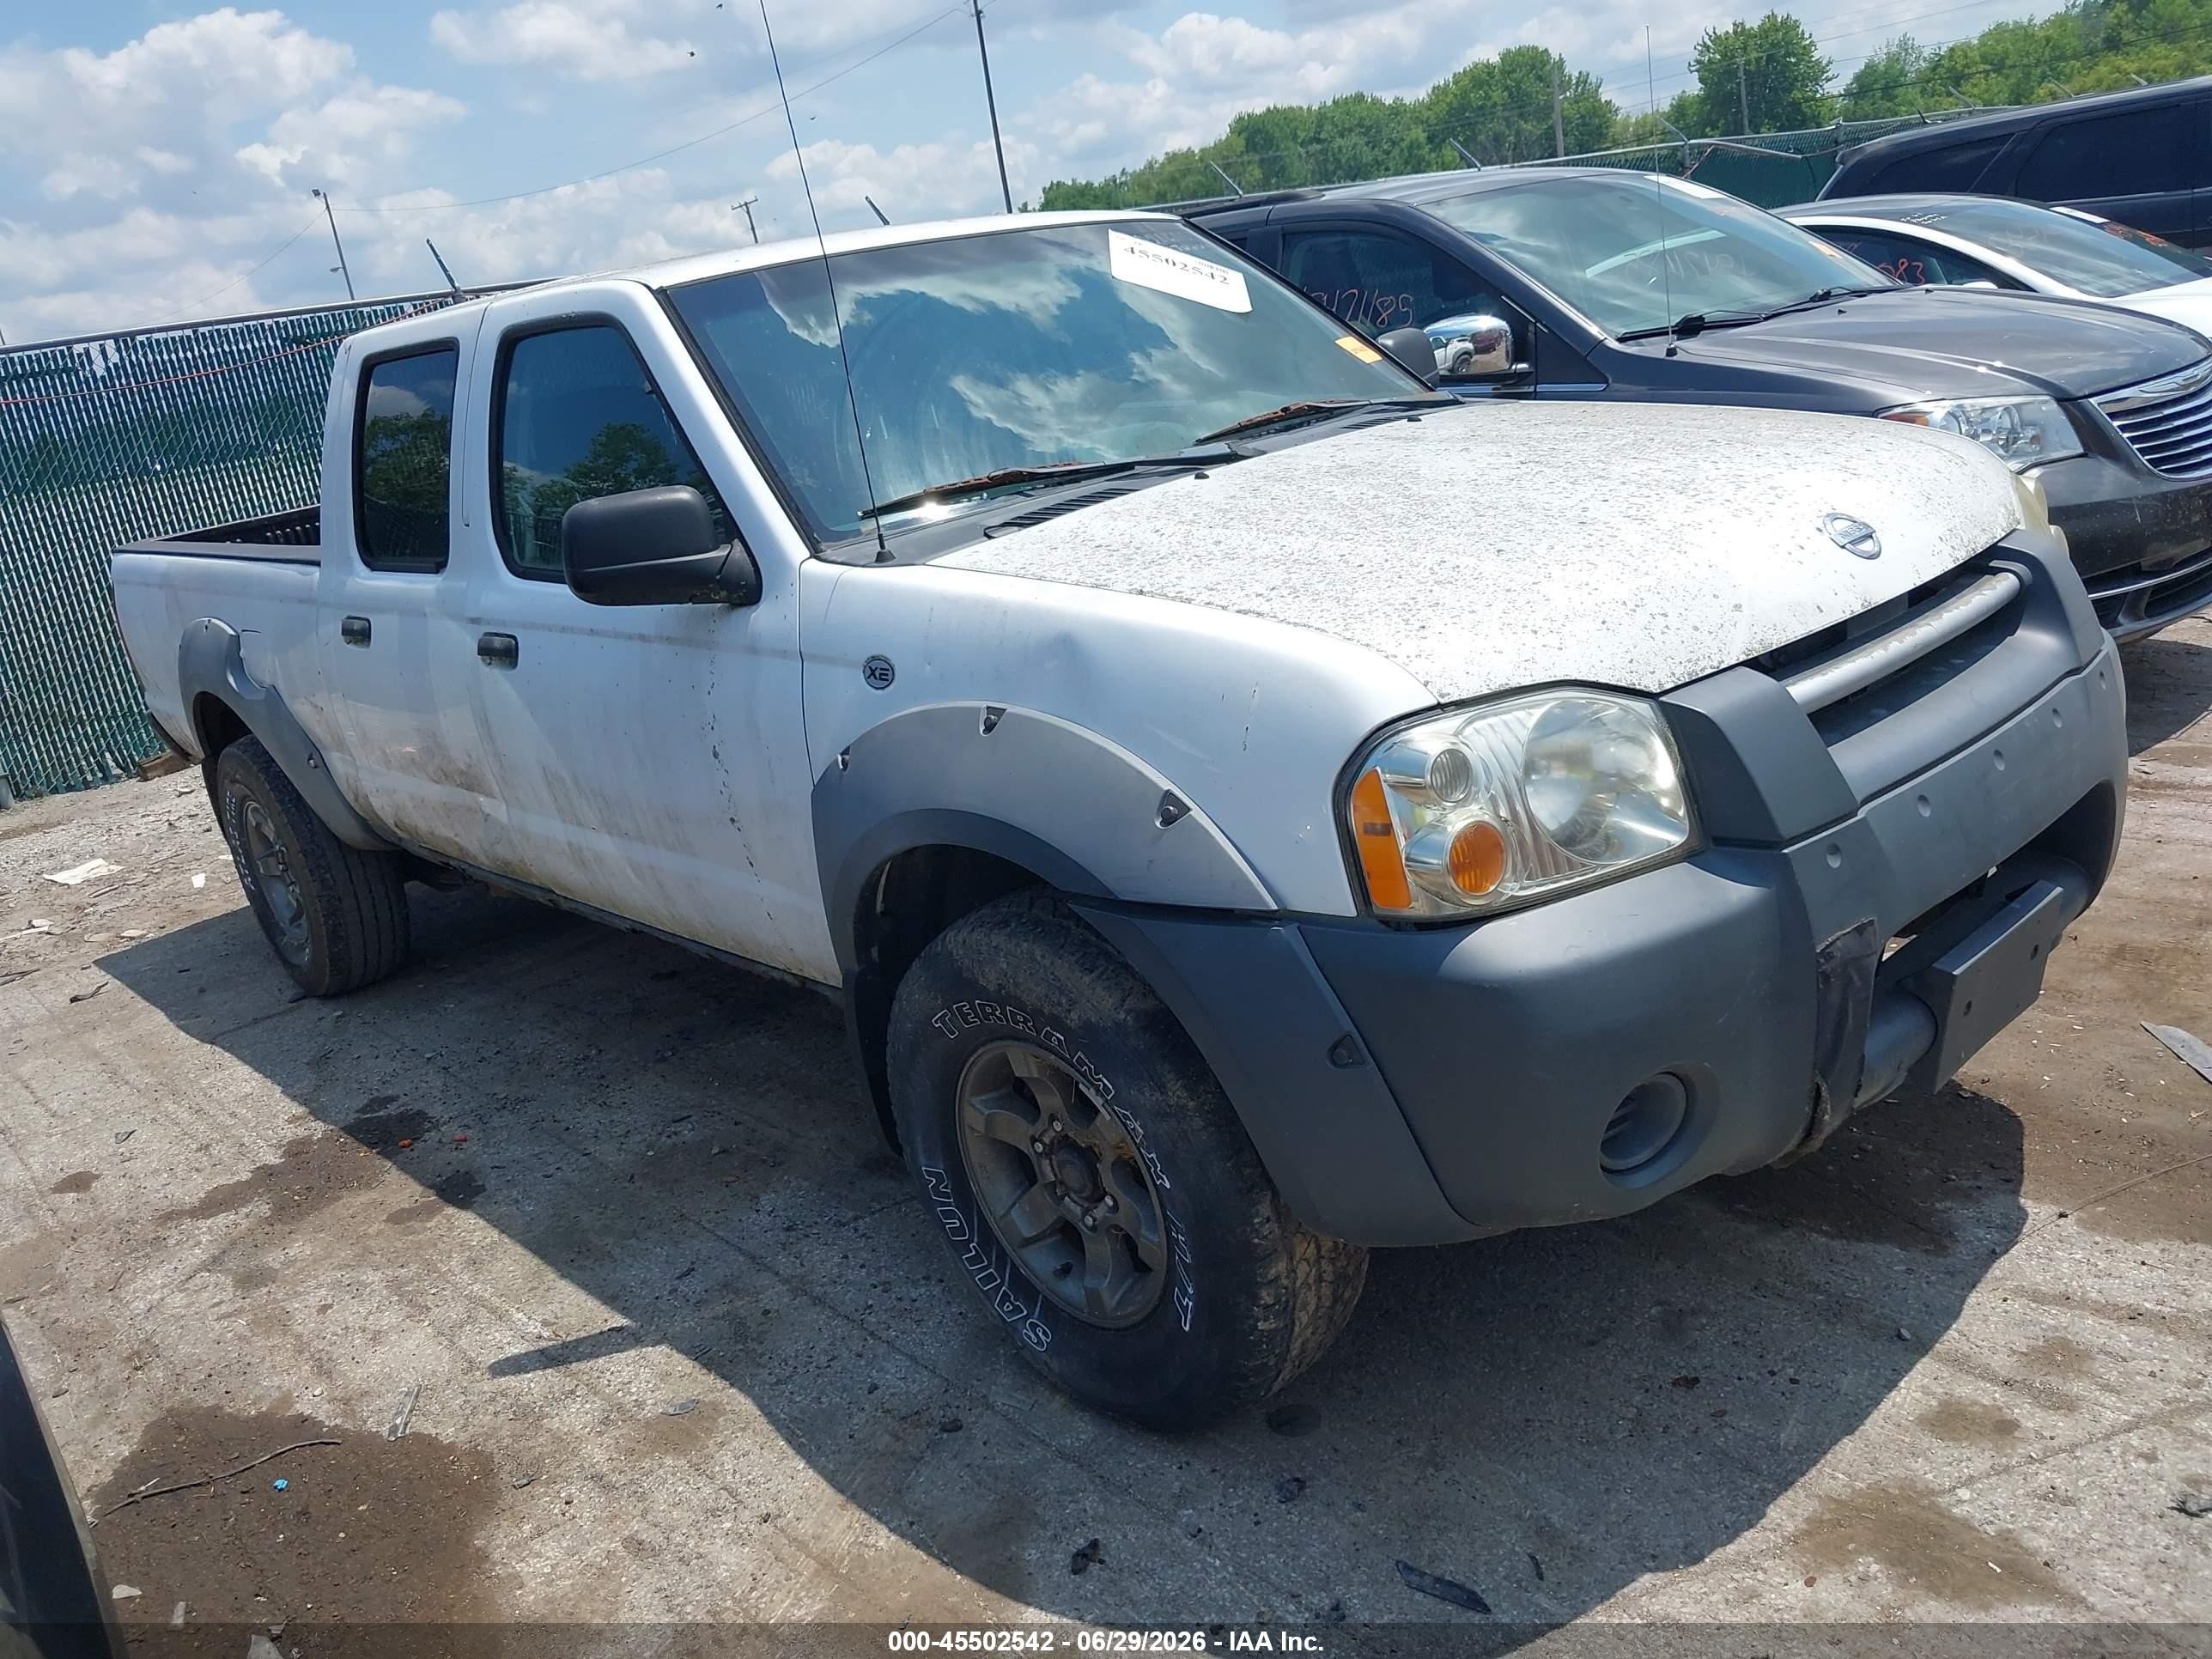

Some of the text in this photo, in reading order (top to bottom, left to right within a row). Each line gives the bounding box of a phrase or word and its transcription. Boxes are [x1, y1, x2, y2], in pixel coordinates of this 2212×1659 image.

[1123, 246, 1231, 285] 45502542
[866, 665, 890, 682] XE
[932, 1000, 1170, 1189] TERRAMAX
[921, 1166, 1052, 1352] SAILUN
